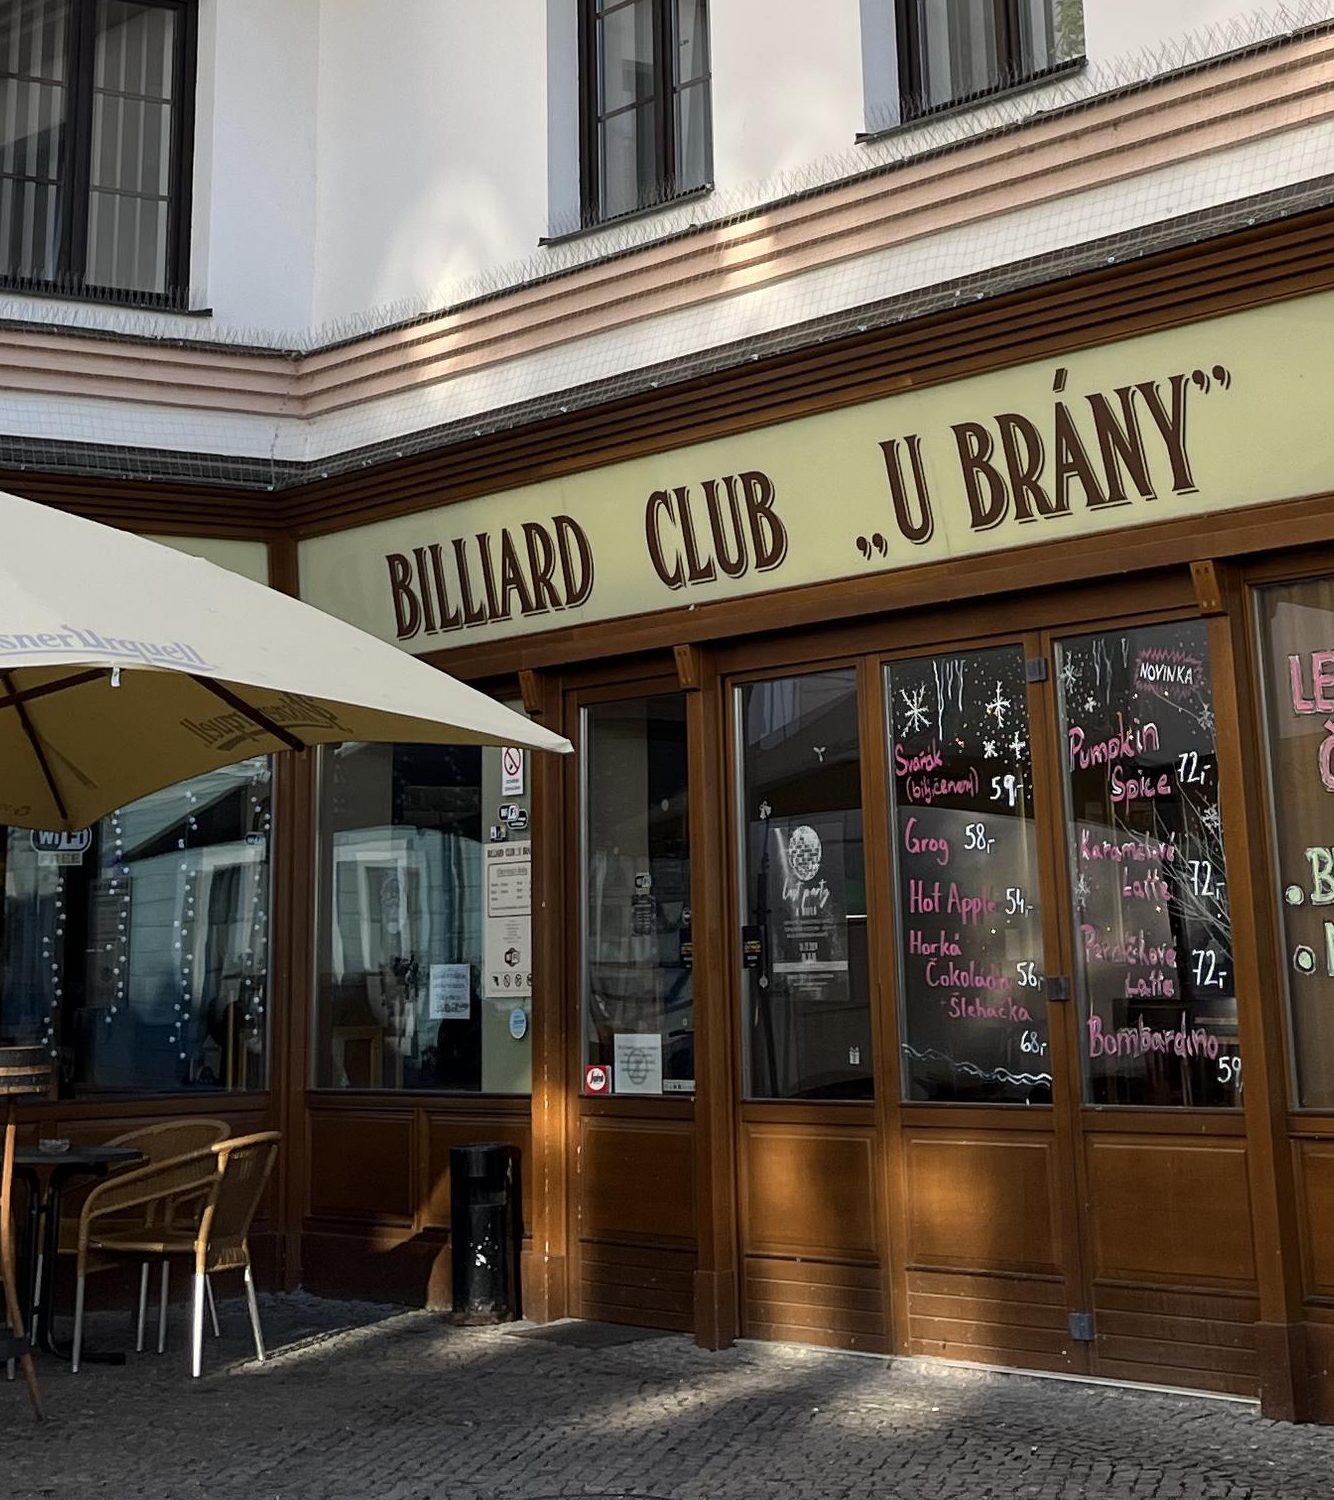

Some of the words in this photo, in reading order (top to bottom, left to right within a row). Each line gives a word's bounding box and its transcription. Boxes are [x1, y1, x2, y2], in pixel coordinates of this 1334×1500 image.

[386, 515, 595, 642] BILLIARD
[645, 470, 788, 592] CLUB
[60, 624, 207, 664] Urquell
[1140, 662, 1194, 685] NOVINKA
[1068, 711, 1160, 782] Pumpkin
[1109, 765, 1172, 814] Spice
[905, 817, 950, 866] Grog
[1081, 828, 1176, 862] Karamelové
[909, 879, 942, 913] Hot
[947, 882, 997, 925] Apple
[1123, 866, 1171, 900] Latte
[909, 930, 963, 956] Horká
[1125, 969, 1175, 998] Latte
[1087, 1011, 1218, 1061] Bombardino
